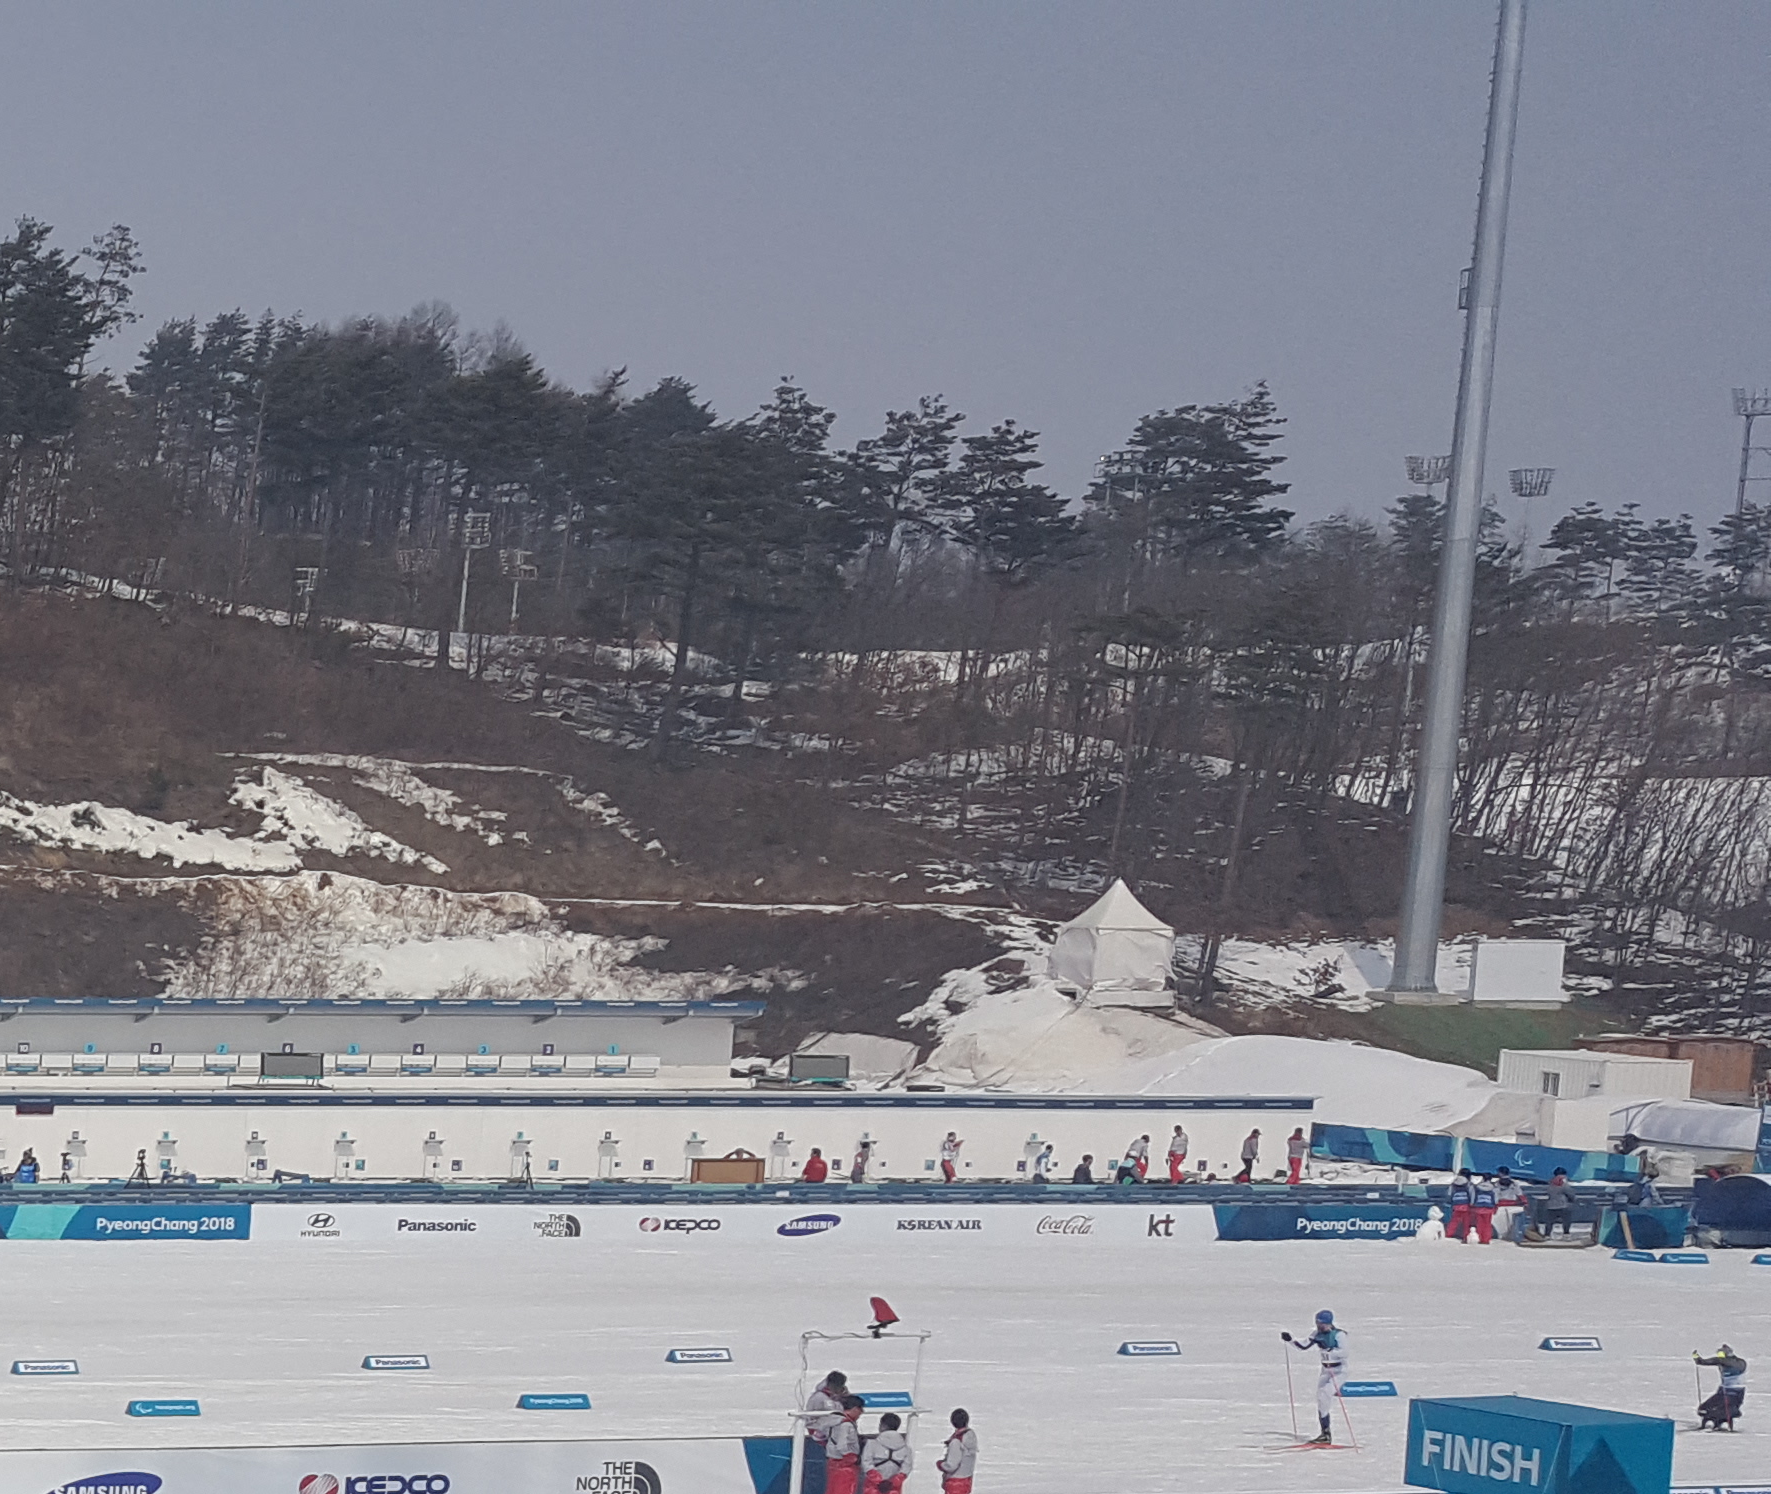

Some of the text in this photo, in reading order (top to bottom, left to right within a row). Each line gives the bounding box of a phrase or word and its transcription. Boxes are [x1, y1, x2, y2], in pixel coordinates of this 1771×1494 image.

[548, 1213, 566, 1221] THE
[95, 1216, 236, 1234] PyeongChang 2018
[397, 1219, 477, 1232] Panasonic
[533, 1221, 566, 1230] NORTH
[784, 1220, 835, 1230] SAMSUNG
[954, 1219, 983, 1230] AIR
[1147, 1213, 1176, 1238] kt
[1297, 1217, 1424, 1234] PyeongChang 2018
[300, 1229, 342, 1238] HYUNDAI
[1421, 1429, 1540, 1487] FINISH
[602, 1461, 634, 1476] THE
[575, 1476, 634, 1491] NORTH
